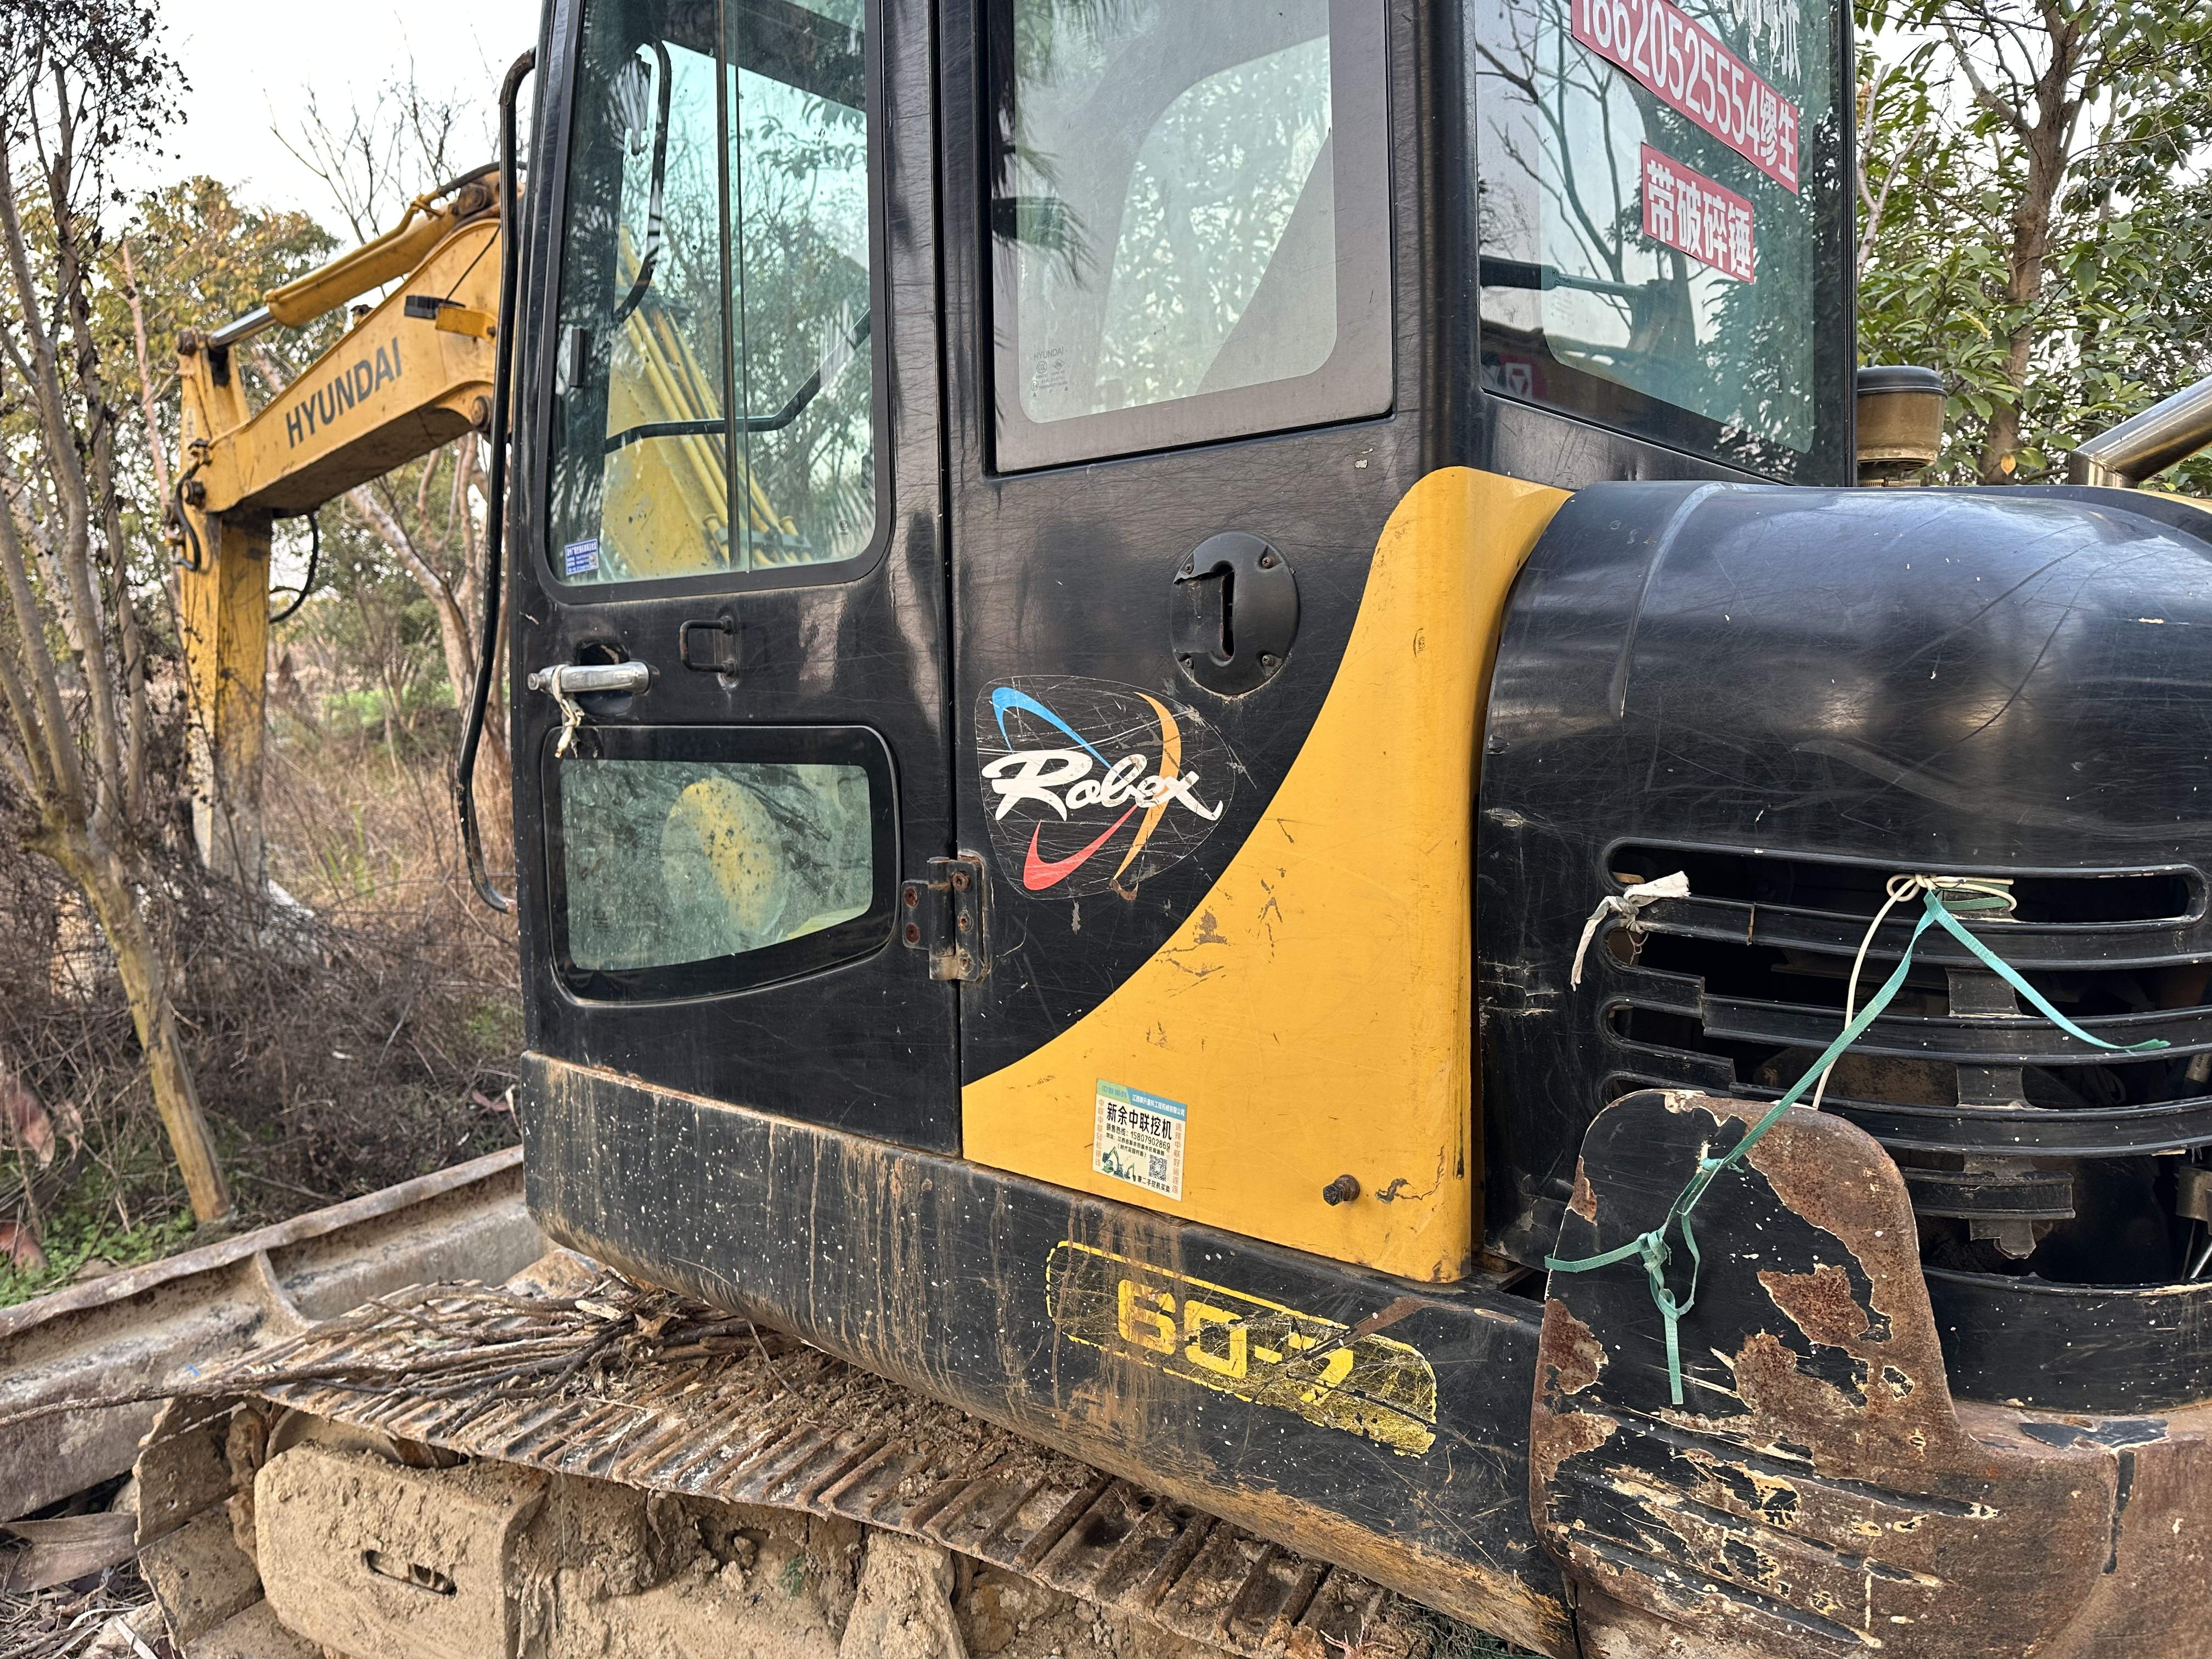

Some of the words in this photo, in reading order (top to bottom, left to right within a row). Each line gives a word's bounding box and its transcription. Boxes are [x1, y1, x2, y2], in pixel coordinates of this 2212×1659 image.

[1647, 160, 1751, 278] 带破碎锤
[1034, 346, 1064, 360] HYUNDAI
[286, 337, 402, 449] HYUNDAI
[982, 749, 1223, 821] Robex
[1107, 1102, 1172, 1140] 新余中联挖机
